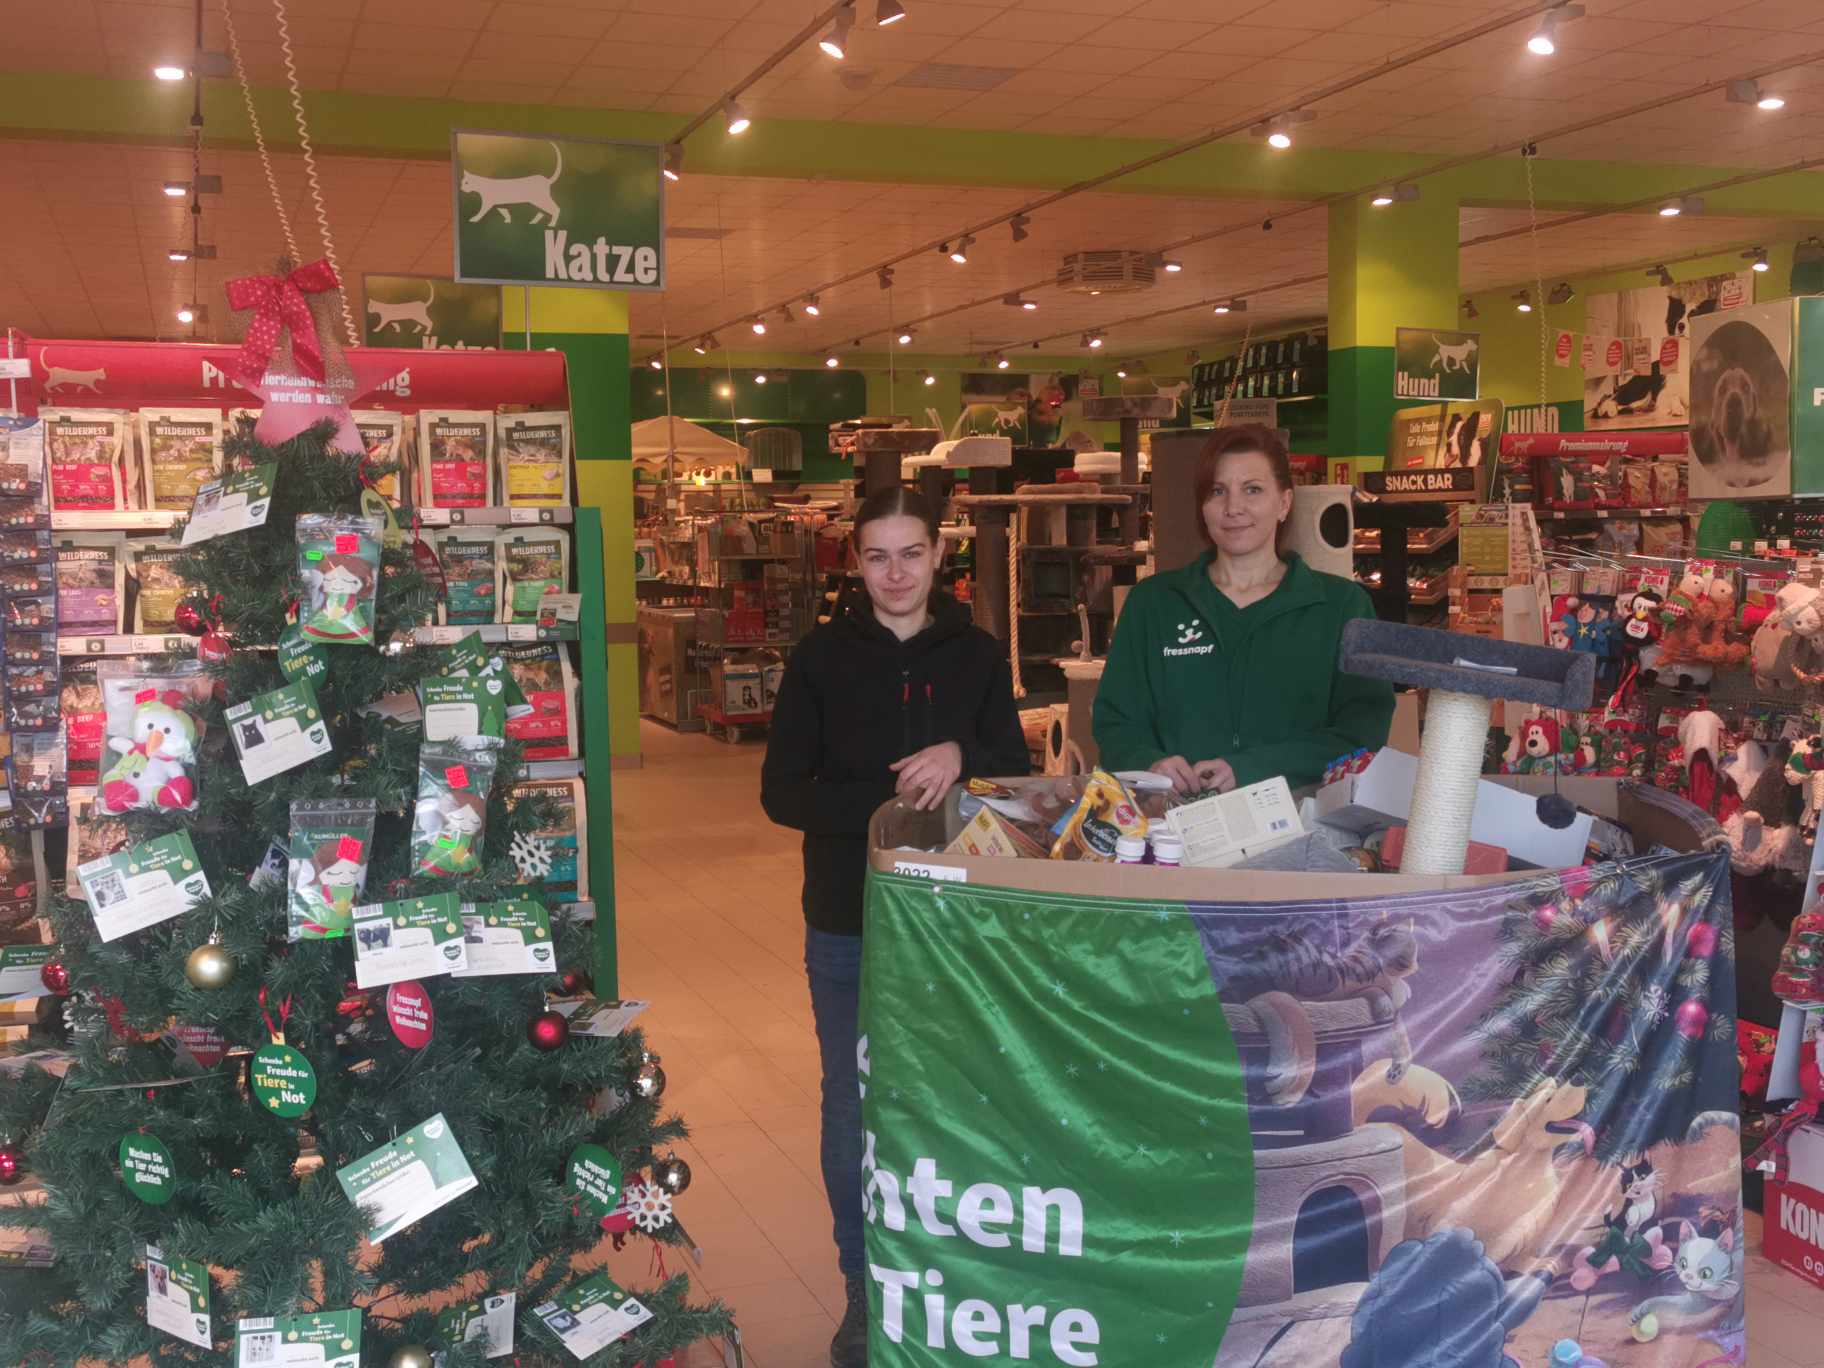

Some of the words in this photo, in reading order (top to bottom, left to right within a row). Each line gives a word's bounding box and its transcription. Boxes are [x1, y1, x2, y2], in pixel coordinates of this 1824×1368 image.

[544, 229, 658, 284] Katze
[1397, 371, 1440, 397] Hund
[56, 427, 107, 436] WILDERNESS
[156, 427, 206, 436] WILDERNESS
[435, 427, 480, 437] WILDERNESS
[1385, 474, 1425, 491] SNACK
[1427, 473, 1453, 489] BAR
[58, 551, 109, 561] WILDERNESS
[1163, 644, 1215, 657] fressnapf
[266, 1065, 298, 1077] Freude
[255, 1074, 288, 1089] Tiere
[281, 1090, 306, 1105] Not
[868, 1263, 1101, 1367] Tiere
